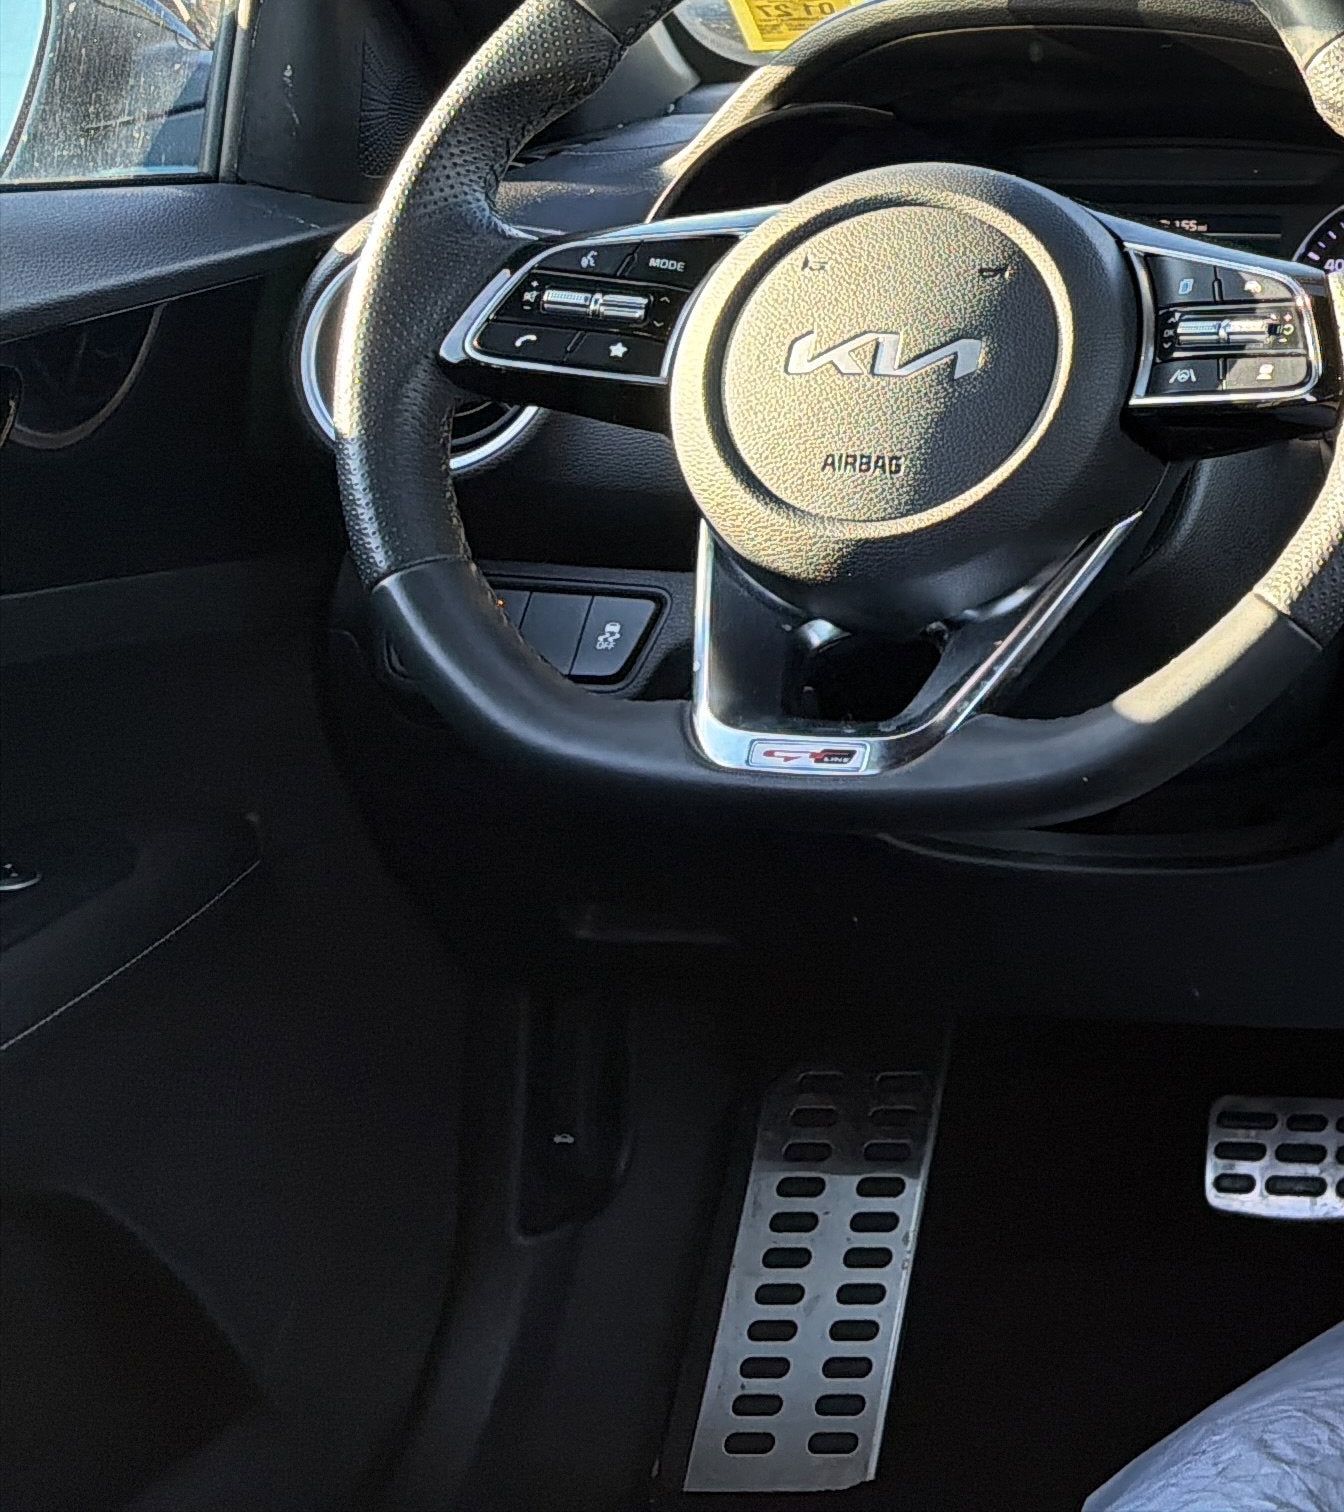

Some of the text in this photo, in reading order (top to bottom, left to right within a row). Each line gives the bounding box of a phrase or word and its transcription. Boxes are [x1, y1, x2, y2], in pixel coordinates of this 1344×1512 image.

[648, 257, 686, 272] MODE
[787, 330, 984, 380] KIA
[820, 453, 905, 475] AIRBAG
